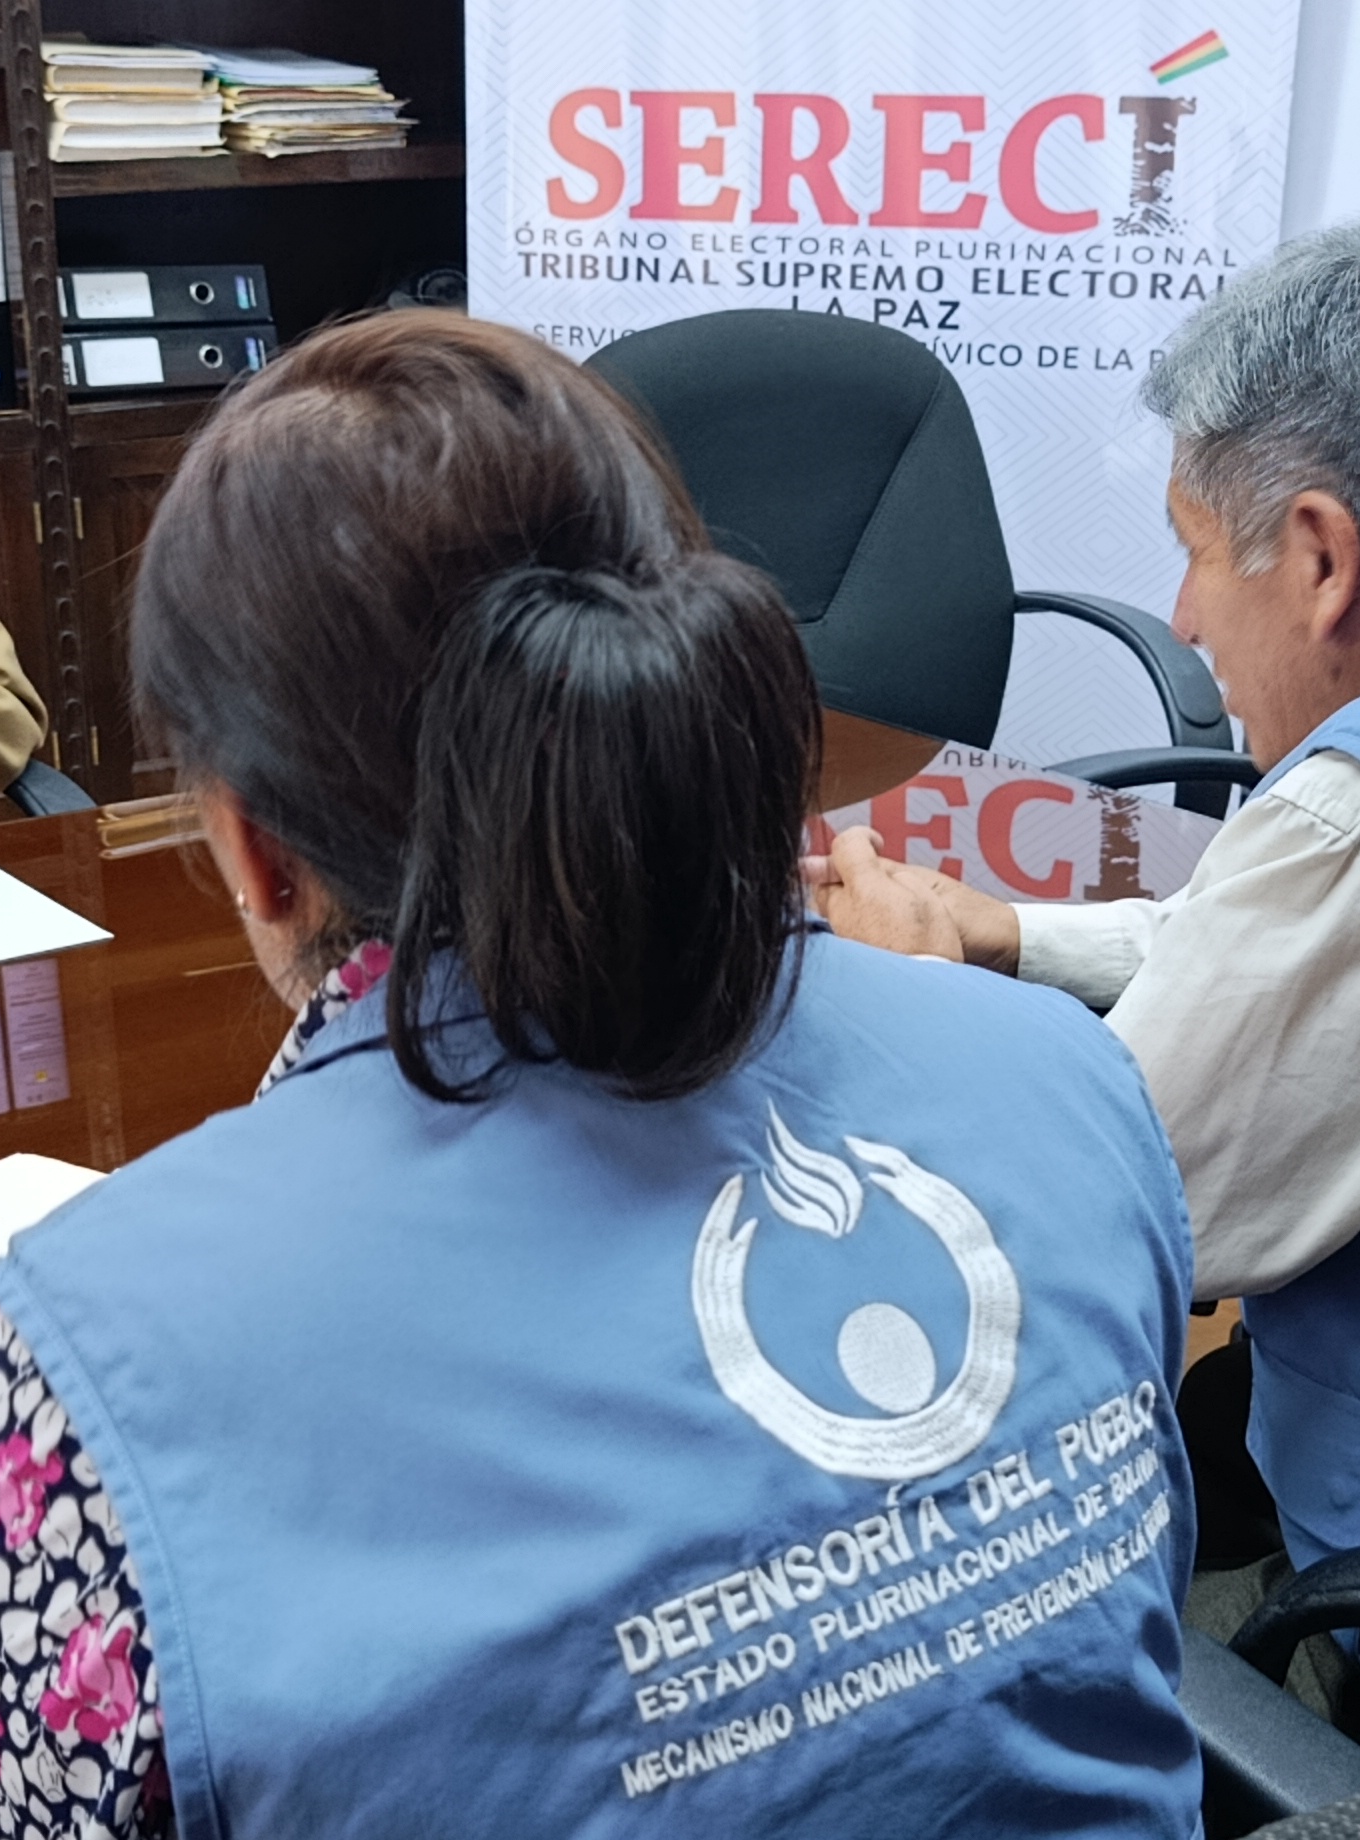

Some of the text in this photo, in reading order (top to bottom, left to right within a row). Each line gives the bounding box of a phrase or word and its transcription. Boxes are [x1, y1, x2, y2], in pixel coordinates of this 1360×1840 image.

[515, 221, 1237, 267] ÓRGANO ELECTORAL PLURINACIONAL
[517, 251, 721, 285] TRIBUNAL
[735, 260, 945, 292] SUPREMO
[872, 298, 961, 331] PAZ
[924, 335, 1023, 368] ÍVICO
[1037, 345, 1079, 370] DE
[1094, 347, 1134, 372] LA
[614, 1484, 953, 1676] DEFENSORÍA
[968, 1448, 1053, 1528] DEL
[1055, 1380, 1157, 1482] PUEBLO
[636, 1630, 797, 1724] ESTADO
[810, 1511, 1072, 1655] PLURINACIONAL
[1073, 1483, 1108, 1528] DE
[620, 1705, 795, 1799] MECANISMO
[801, 1640, 944, 1728] NACIONAL
[944, 1617, 984, 1666] DE
[984, 1544, 1112, 1646] PREVENCIÓN
